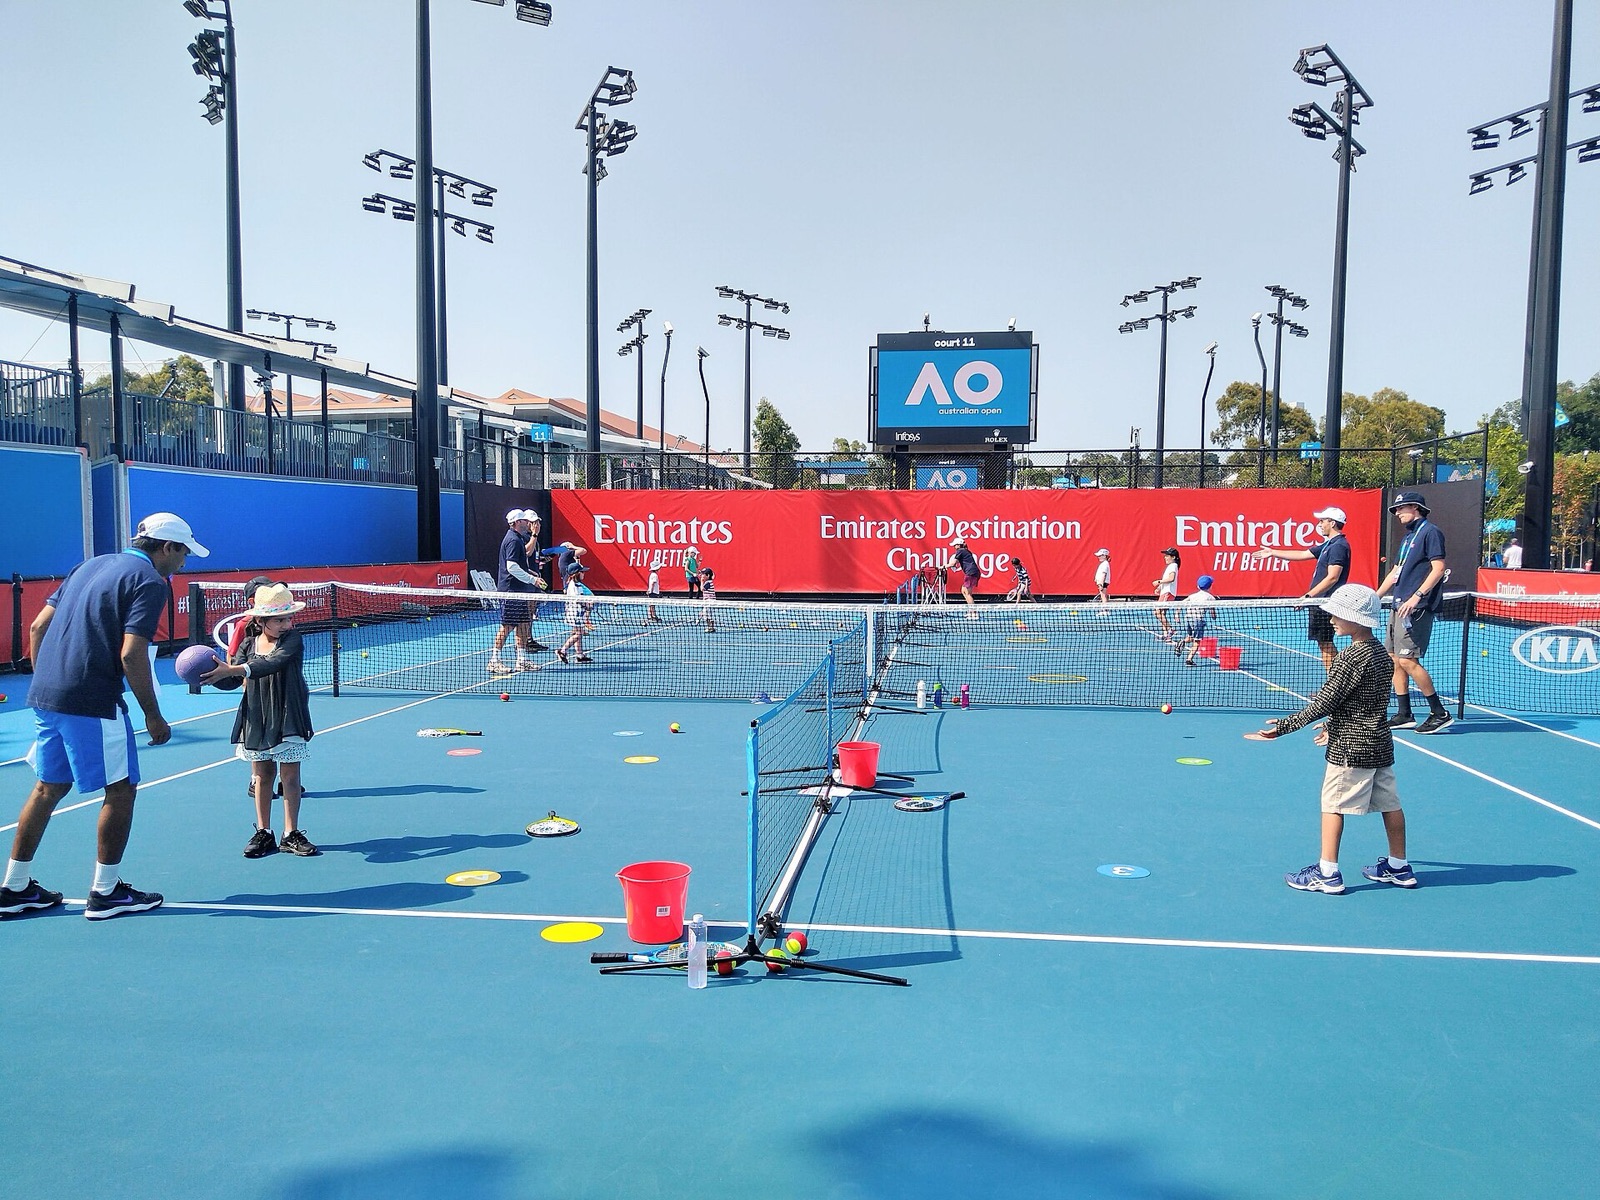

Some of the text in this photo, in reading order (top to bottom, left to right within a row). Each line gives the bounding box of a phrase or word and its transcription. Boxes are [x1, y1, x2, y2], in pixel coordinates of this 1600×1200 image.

[934, 337, 976, 348] court 11
[904, 360, 1003, 405] AO
[938, 407, 1002, 416] australian open
[534, 431, 546, 440] 11
[895, 432, 921, 443] Infosys
[927, 469, 968, 488] AO
[592, 513, 733, 544] Emirates
[820, 515, 1081, 540] Emirates Destination
[1175, 514, 1328, 547] Emirates
[629, 549, 698, 567] FLY BETT
[886, 547, 1010, 578] Challge
[1213, 552, 1239, 571] FLY
[437, 573, 460, 586] Emirates
[1496, 581, 1527, 595] Emirates
[1530, 636, 1599, 663] KIA
